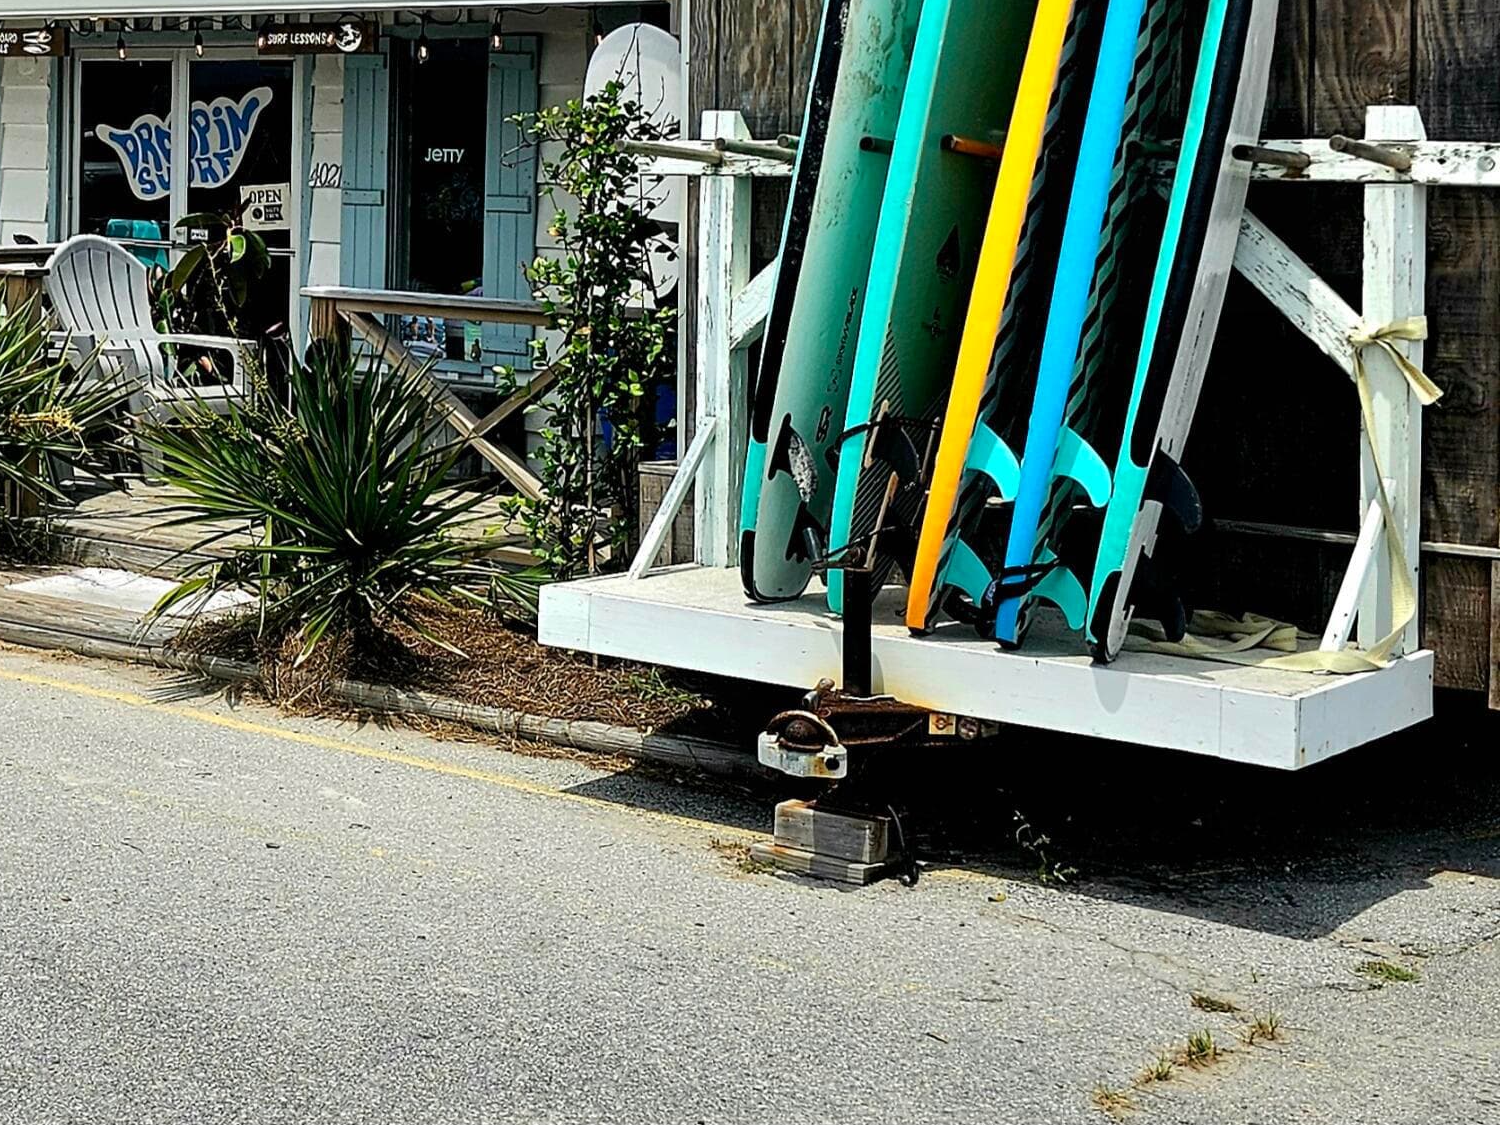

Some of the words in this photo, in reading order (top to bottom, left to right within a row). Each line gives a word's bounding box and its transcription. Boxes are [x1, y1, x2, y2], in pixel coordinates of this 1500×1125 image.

[267, 33, 288, 45] SURF
[290, 32, 327, 45] LESSONS
[249, 188, 282, 204] OPEN
